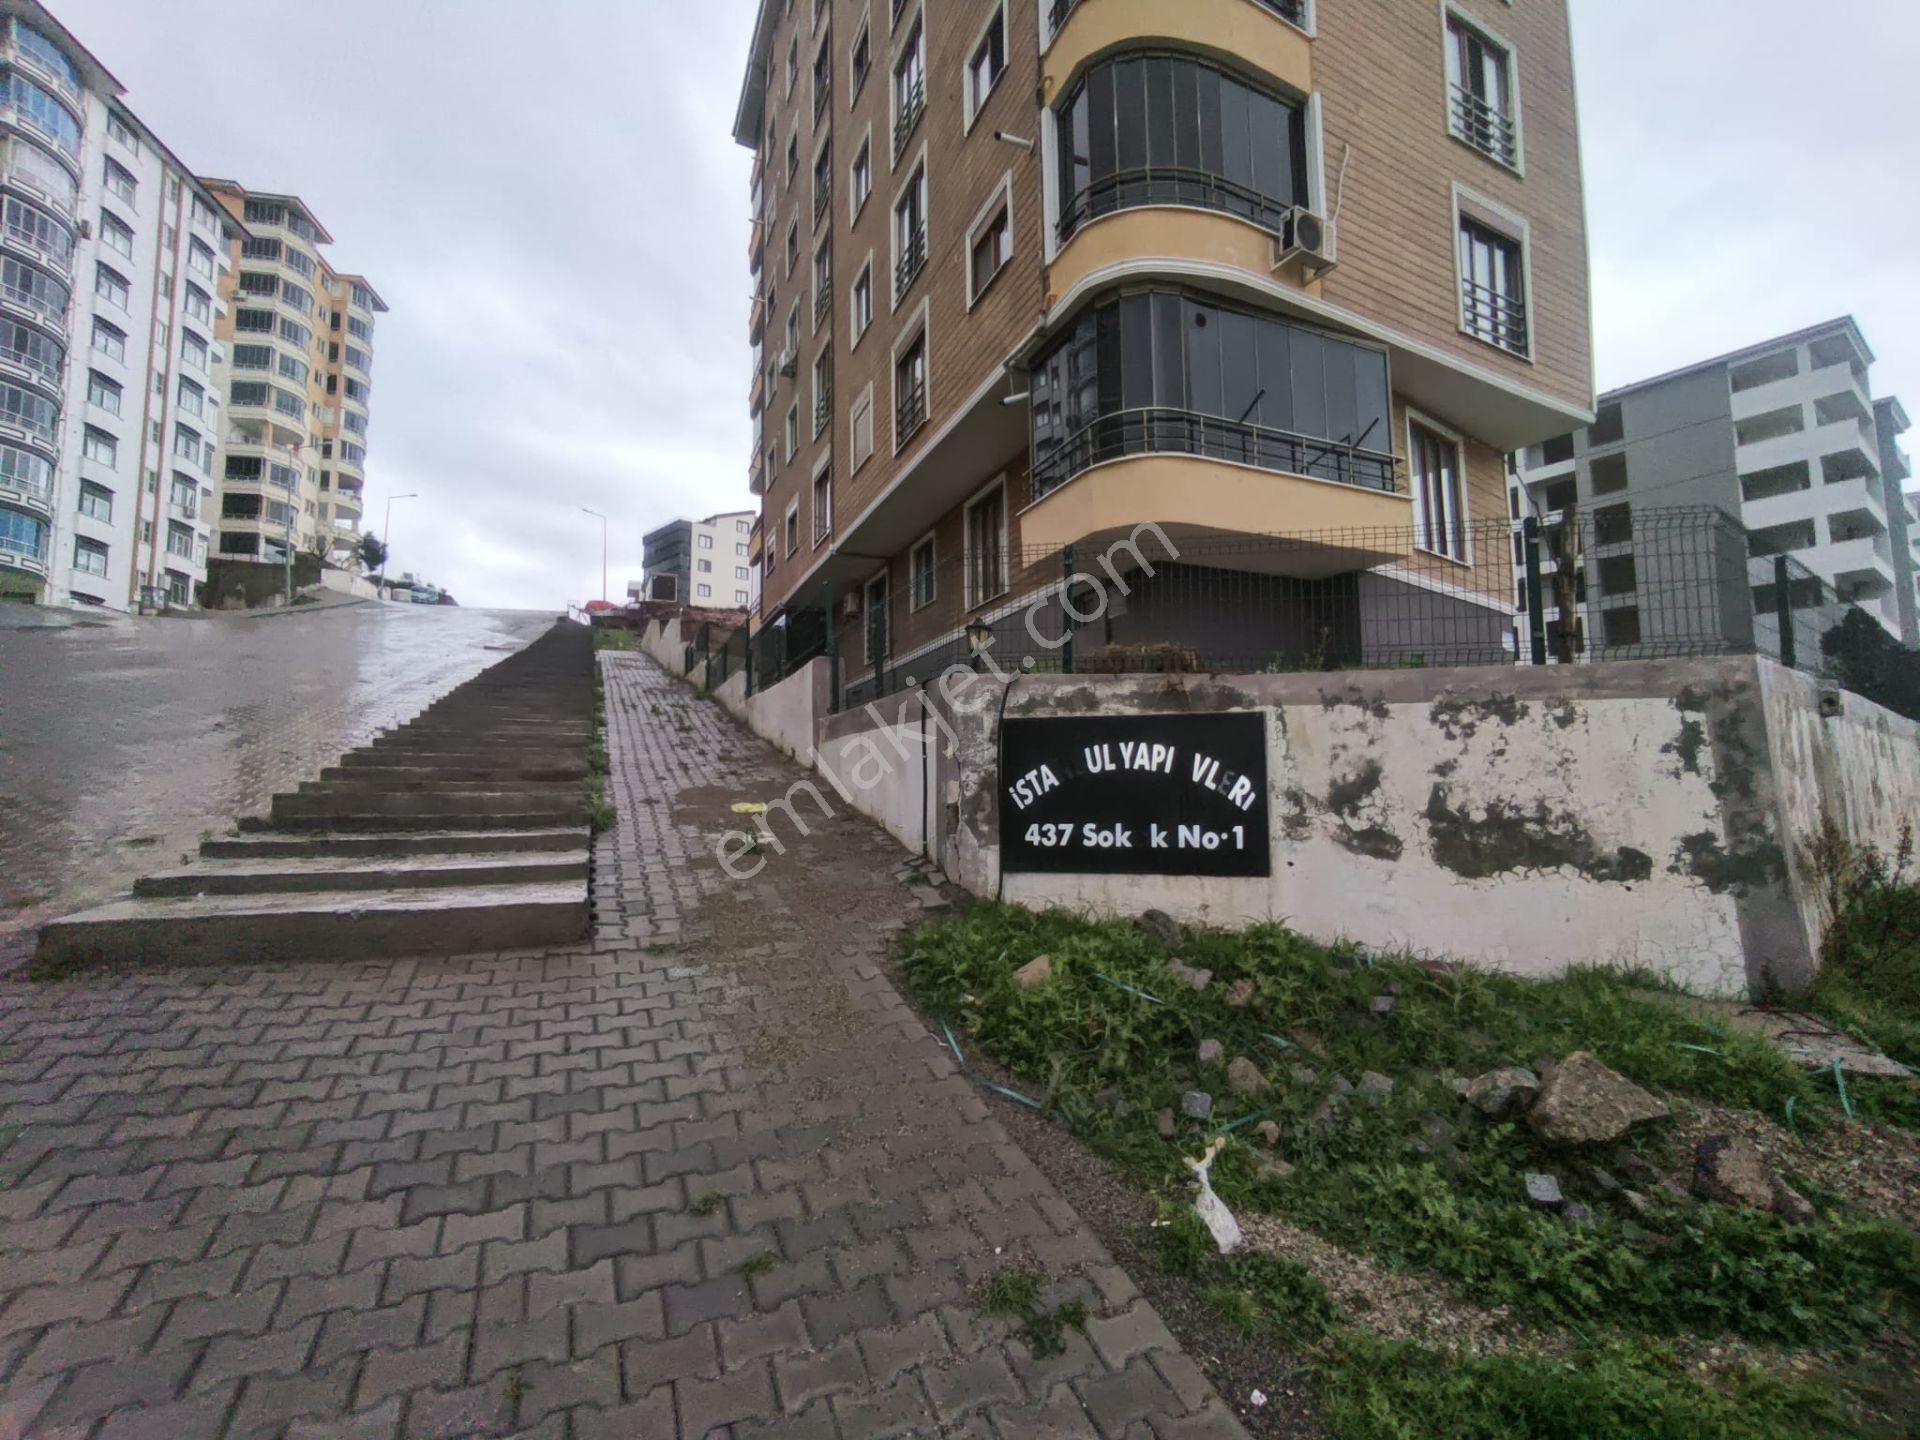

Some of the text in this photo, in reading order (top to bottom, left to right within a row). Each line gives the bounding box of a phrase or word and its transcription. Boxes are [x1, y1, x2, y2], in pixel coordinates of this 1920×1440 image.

[1118, 741, 1175, 774] YAPI
[1024, 823, 1074, 847] 437
[1082, 823, 1169, 848] Sokk
